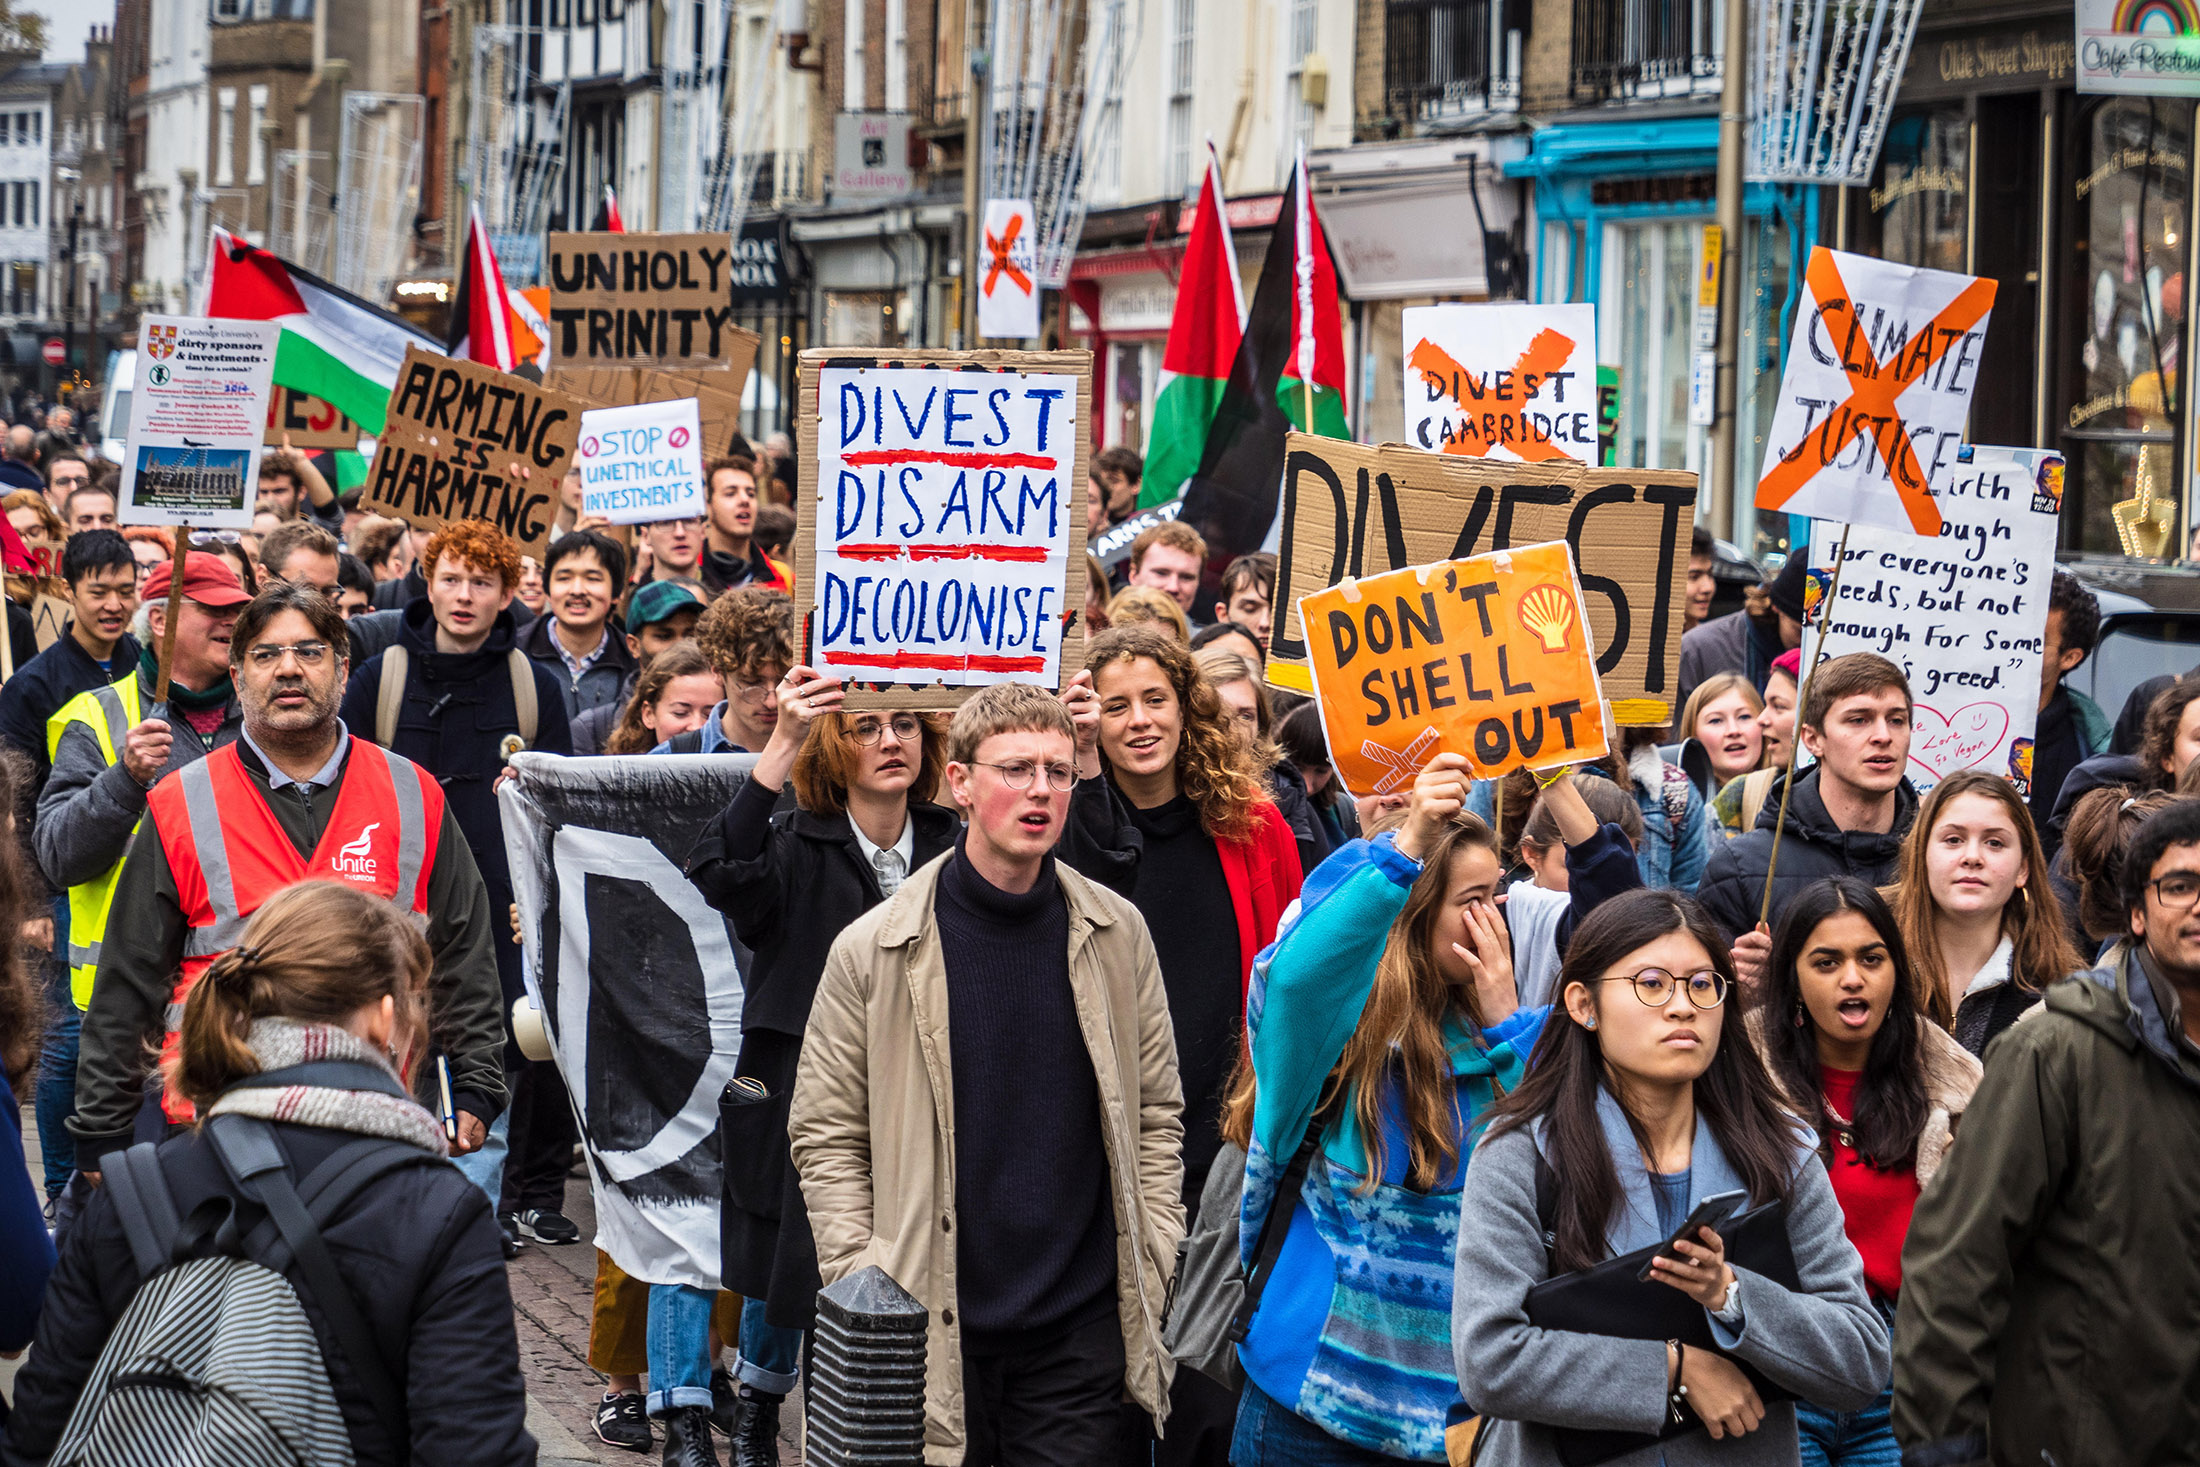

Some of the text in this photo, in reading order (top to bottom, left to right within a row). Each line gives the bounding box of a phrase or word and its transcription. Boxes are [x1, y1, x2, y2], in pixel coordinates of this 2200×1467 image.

[1940, 39, 1975, 81] Olde
[1977, 38, 2018, 77] Sweet
[860, 120, 888, 136] Art
[840, 170, 906, 190] Gallery
[552, 247, 727, 292] UNHOLY
[178, 339, 263, 352] dirty sponsors
[183, 326, 259, 340] Cambridge University's
[550, 306, 731, 358] TRINITY
[1808, 298, 1983, 396] CLIMATE
[176, 352, 186, 361] &
[188, 352, 260, 363] investments
[1426, 370, 1575, 403] DIVEST
[397, 361, 568, 468] ARMING
[841, 382, 1066, 452] DIVEST
[1416, 412, 1596, 449] CAMBRIDGE
[450, 437, 494, 471] IS
[601, 427, 663, 457] STOP
[1778, 396, 1960, 497] JUSTICE
[586, 458, 692, 484] UNETHICAL
[1949, 472, 2010, 501] rth
[372, 447, 550, 543] HARMING
[586, 482, 694, 511] INVESTMENTS
[836, 467, 1058, 541] DISARM
[1097, 512, 1159, 557] ARMS
[1939, 518, 2011, 562] ough
[1879, 551, 2029, 593] everyone's
[822, 571, 1055, 652] DECOLONISE
[1328, 568, 1500, 669] DON'T
[1916, 590, 1966, 612] but
[1977, 595, 2027, 616] not
[1361, 644, 1535, 726] SHELL
[1474, 699, 1582, 766] OUT
